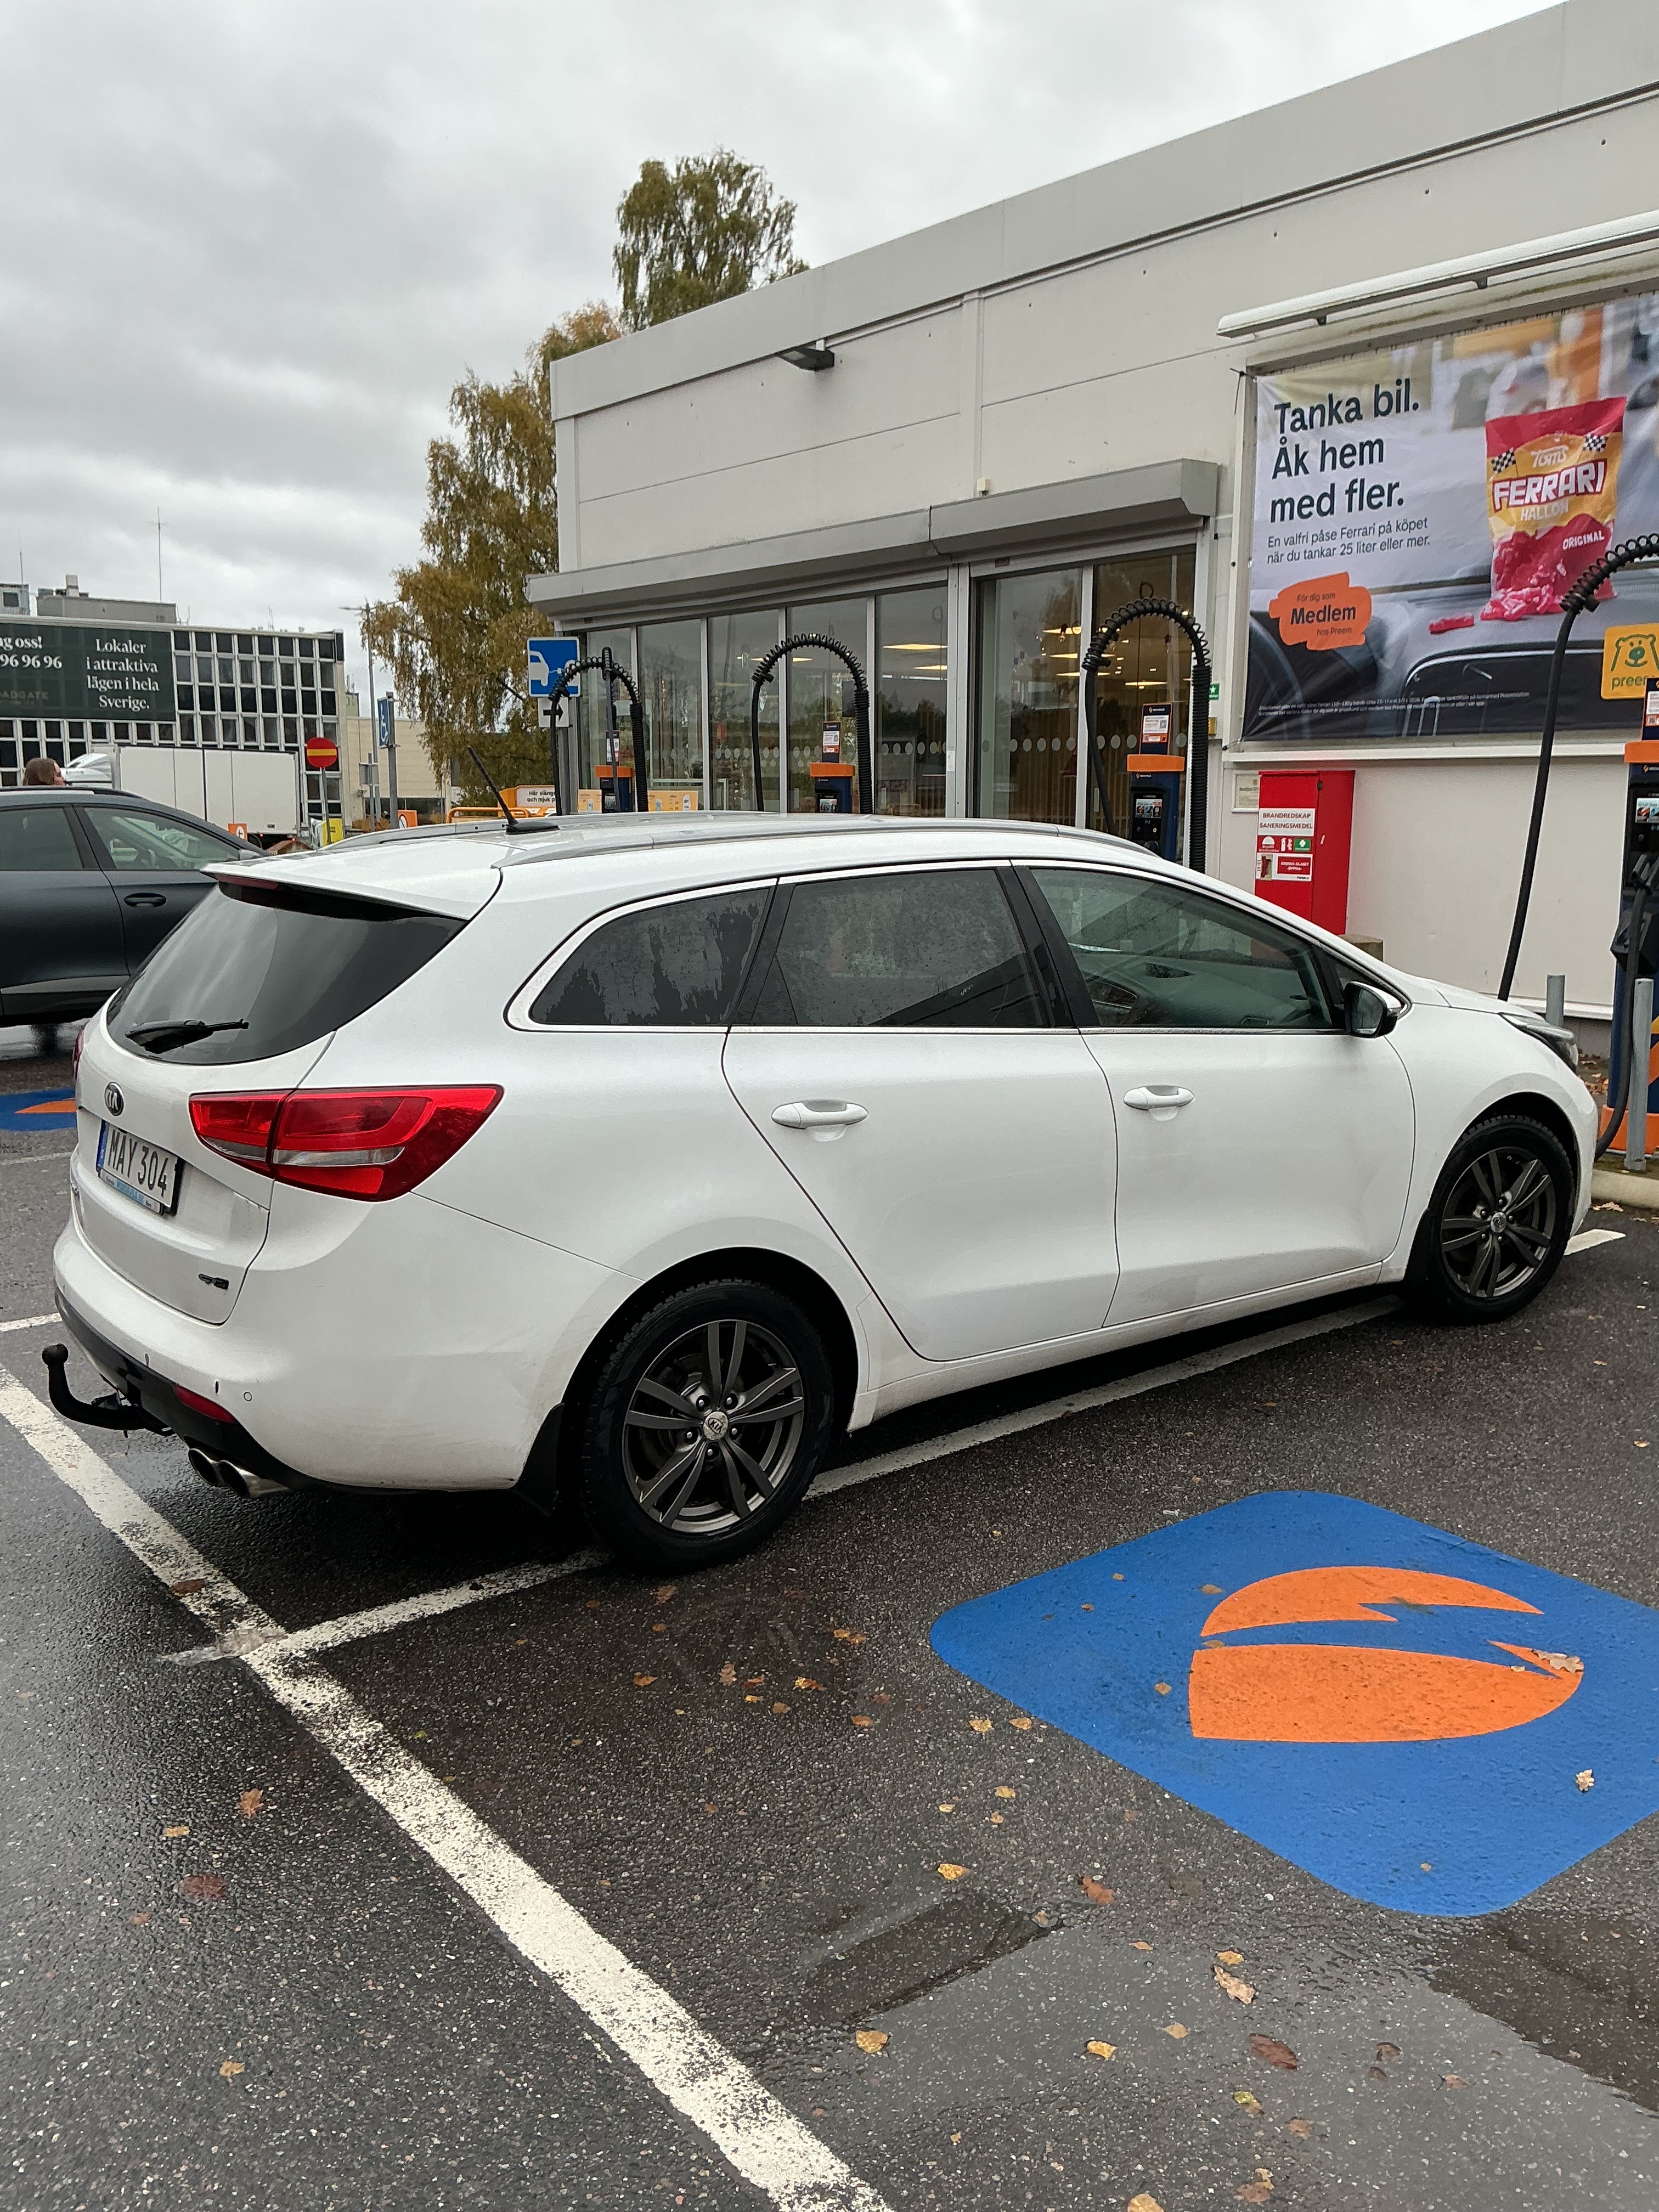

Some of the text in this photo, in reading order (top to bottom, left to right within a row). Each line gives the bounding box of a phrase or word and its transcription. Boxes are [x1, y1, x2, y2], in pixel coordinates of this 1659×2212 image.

[1274, 378, 1419, 434] Tanka bil.
[1272, 436, 1384, 480] Åk hem
[1493, 460, 1606, 512] FERRARI
[1271, 478, 1404, 523] med fler.
[1520, 499, 1568, 521] HALLON
[1268, 517, 1427, 548] En valfri påse Ferrari på köpet
[1562, 529, 1605, 551] ORIGINAL
[1267, 535, 1430, 564] när du tankar 25 liter eller mer.
[1310, 592, 1320, 602] dig
[1290, 604, 1356, 625] Medlem
[1331, 627, 1352, 635] Preem
[15, 635, 42, 650] oss!
[95, 638, 146, 654] Lokaler
[0, 653, 63, 669] 96 96 96
[86, 657, 159, 673] i attraktiva
[87, 675, 160, 692] lägen i hela
[99, 695, 150, 712] Sverige.
[108, 1130, 137, 1178] MAY
[138, 1146, 168, 1198] 304
[709, 1419, 723, 1434] KIA
